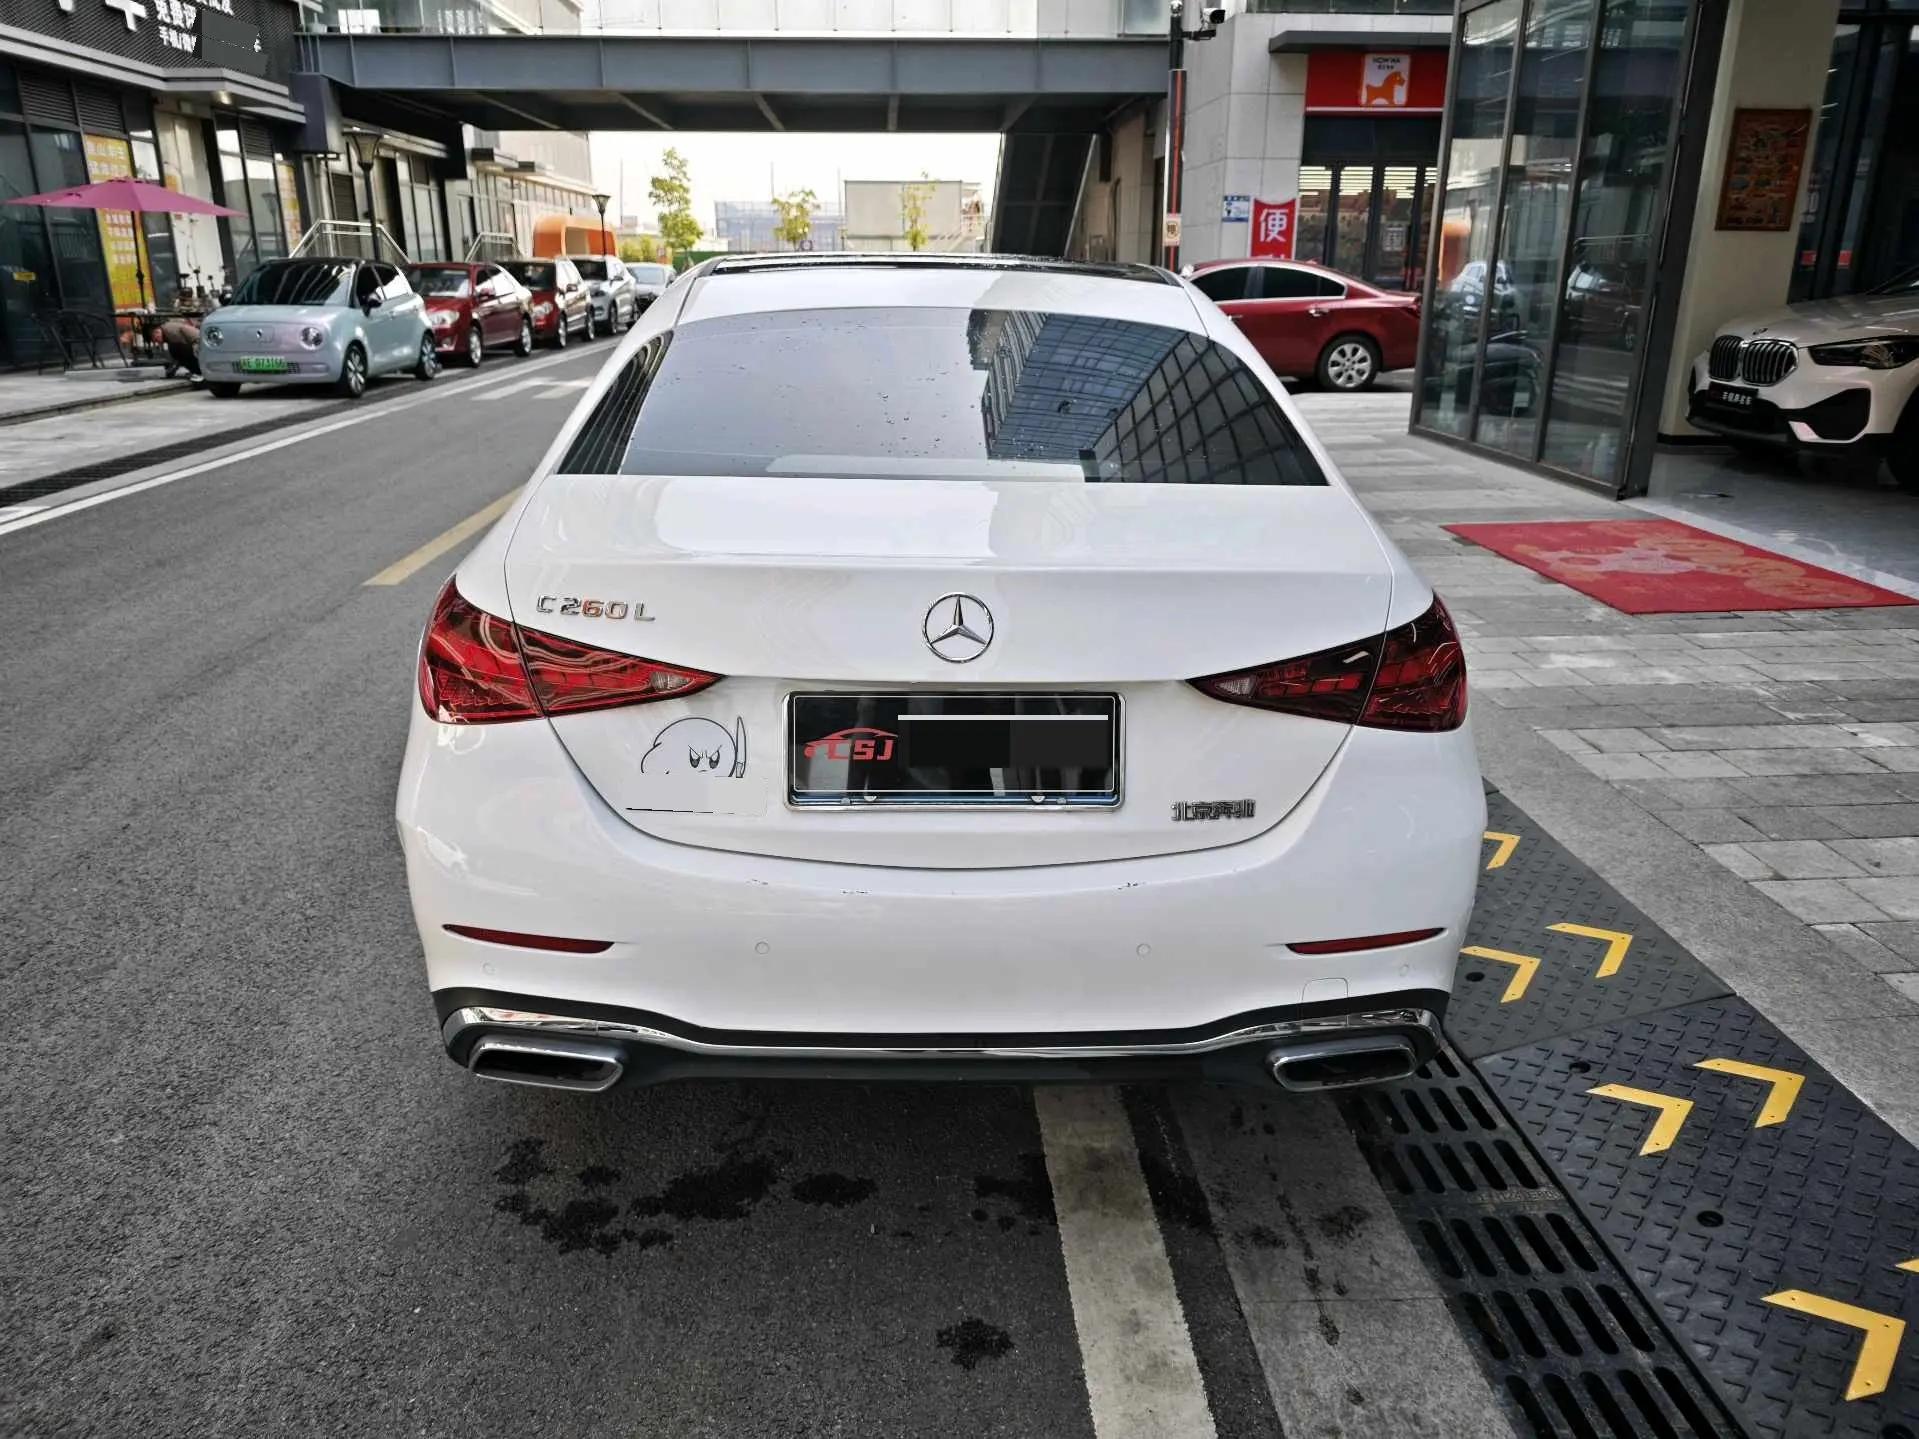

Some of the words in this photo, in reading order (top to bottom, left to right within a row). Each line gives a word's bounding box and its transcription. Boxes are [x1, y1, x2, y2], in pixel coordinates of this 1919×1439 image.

[1257, 208, 1289, 260] 便
[1171, 799, 1255, 821] 北京奔驰
